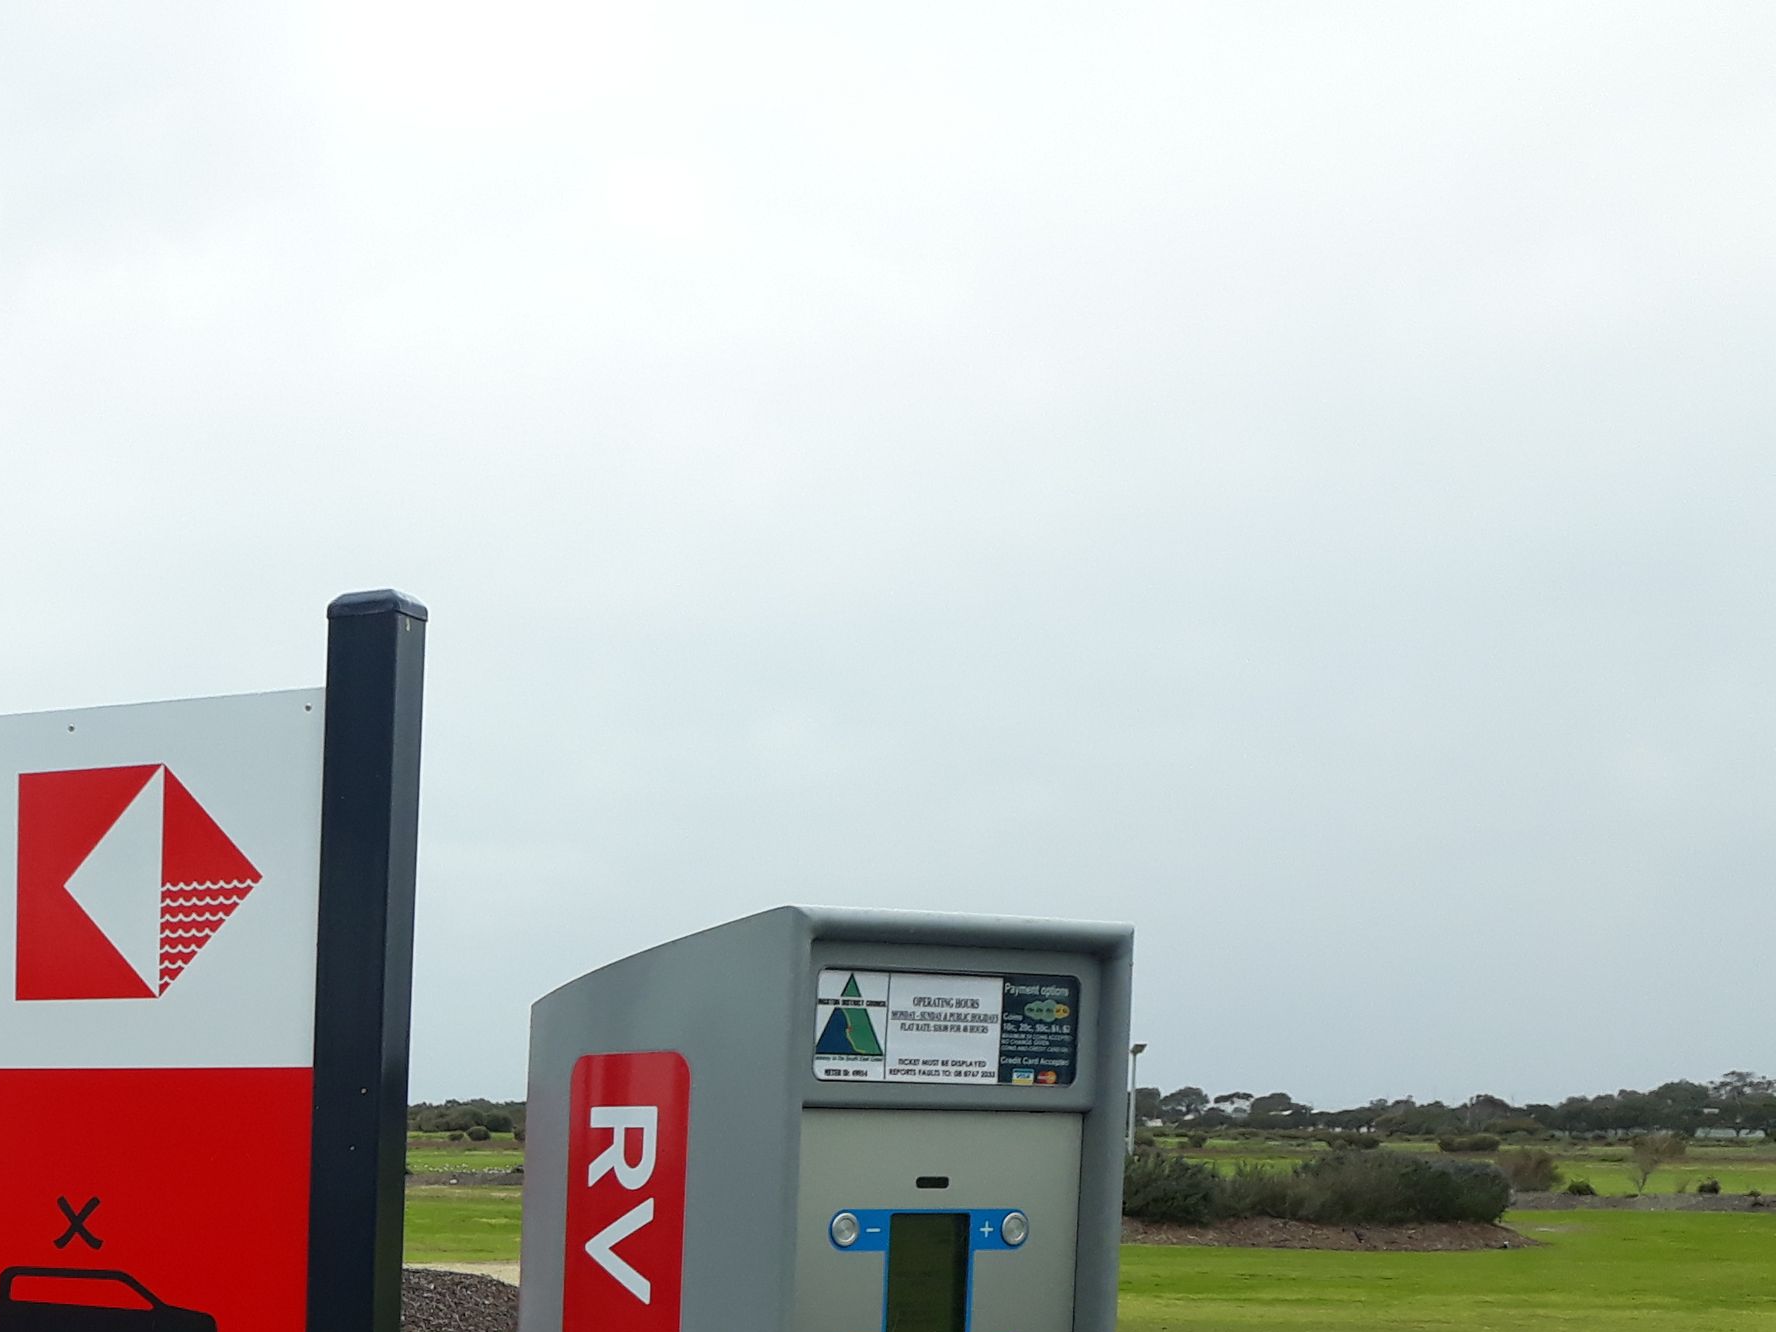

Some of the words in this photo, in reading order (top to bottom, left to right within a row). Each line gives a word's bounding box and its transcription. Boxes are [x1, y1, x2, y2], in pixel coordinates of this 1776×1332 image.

[1004, 982, 1040, 996] Payment
[913, 997, 953, 1009] OPERATING
[955, 998, 980, 1009] HOURS
[951, 1060, 987, 1068] DISPLAYED
[585, 1105, 658, 1305] RV
